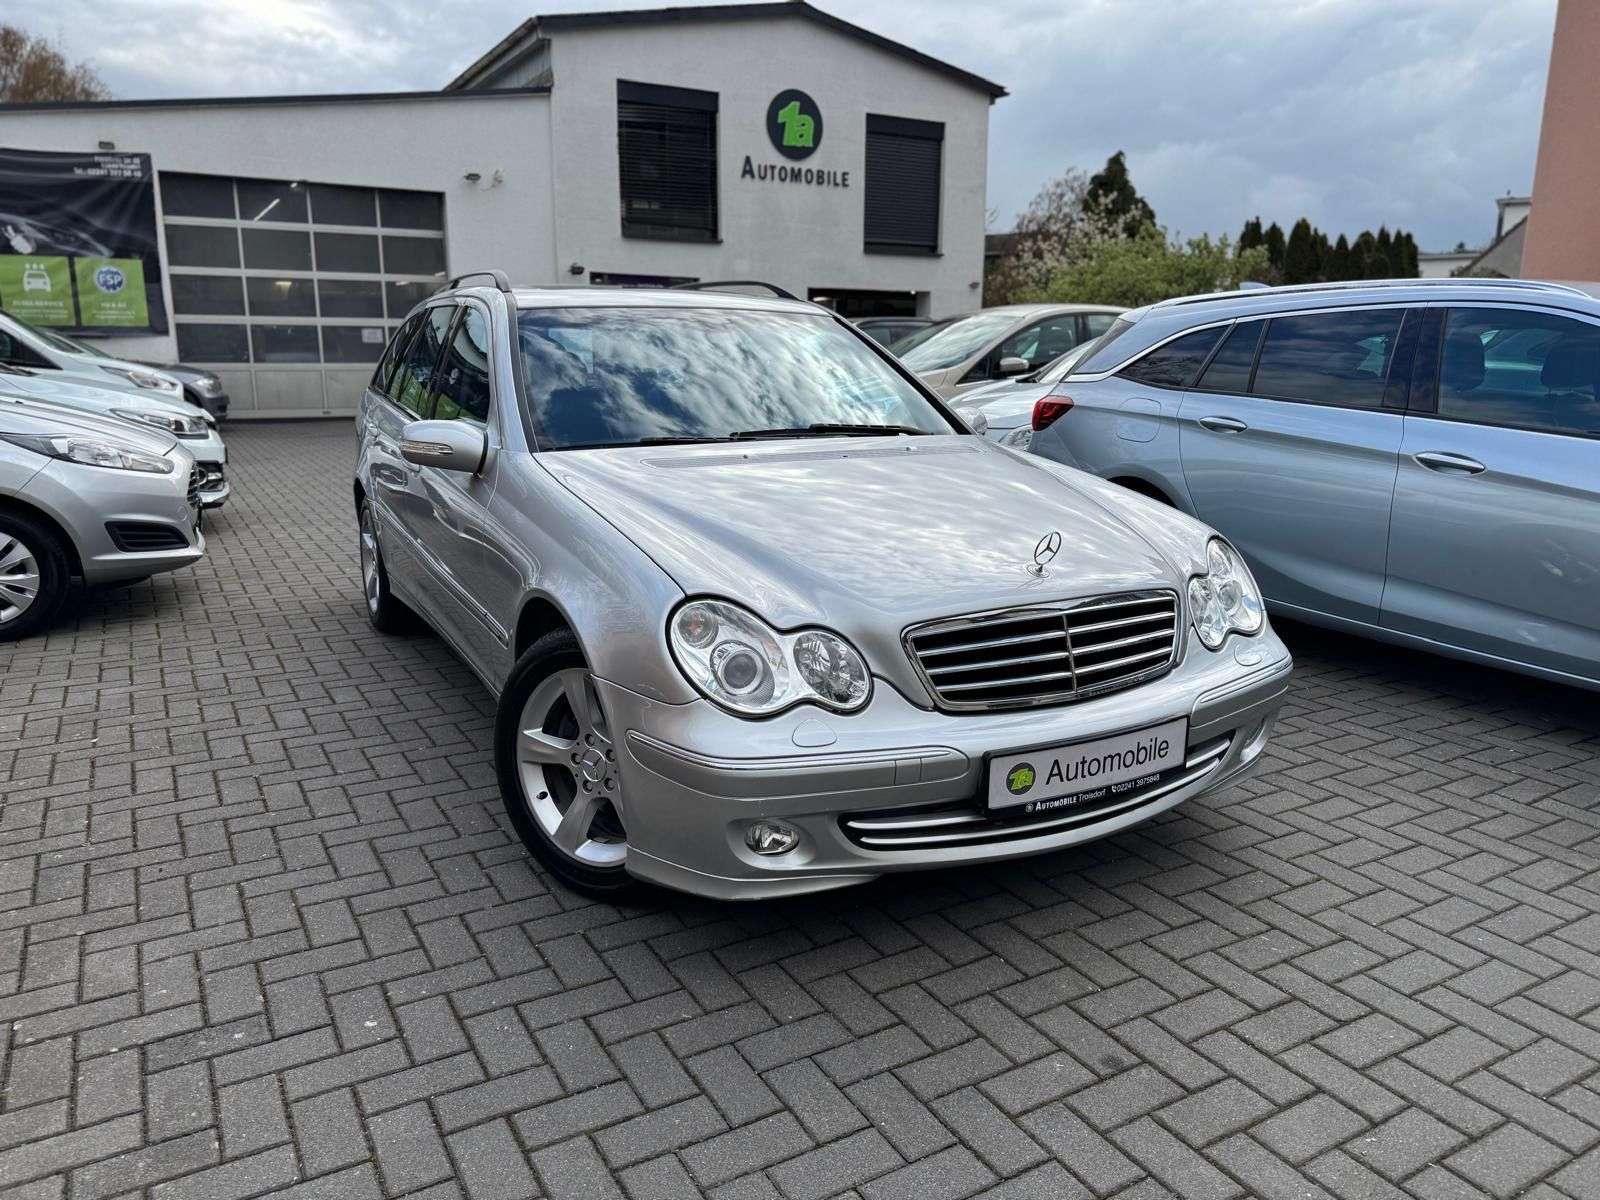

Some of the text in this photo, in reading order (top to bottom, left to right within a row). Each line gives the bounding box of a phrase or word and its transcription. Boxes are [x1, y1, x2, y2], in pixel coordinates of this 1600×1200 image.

[777, 100, 814, 147] 1a
[741, 155, 850, 188] AUTOMOBILE
[99, 273, 122, 286] FSP
[1045, 736, 1169, 786] Automobile
[1035, 795, 1078, 812] AUTOMOBILE
[1078, 788, 1106, 803] Troisdorf
[1116, 781, 1135, 793] 02241
